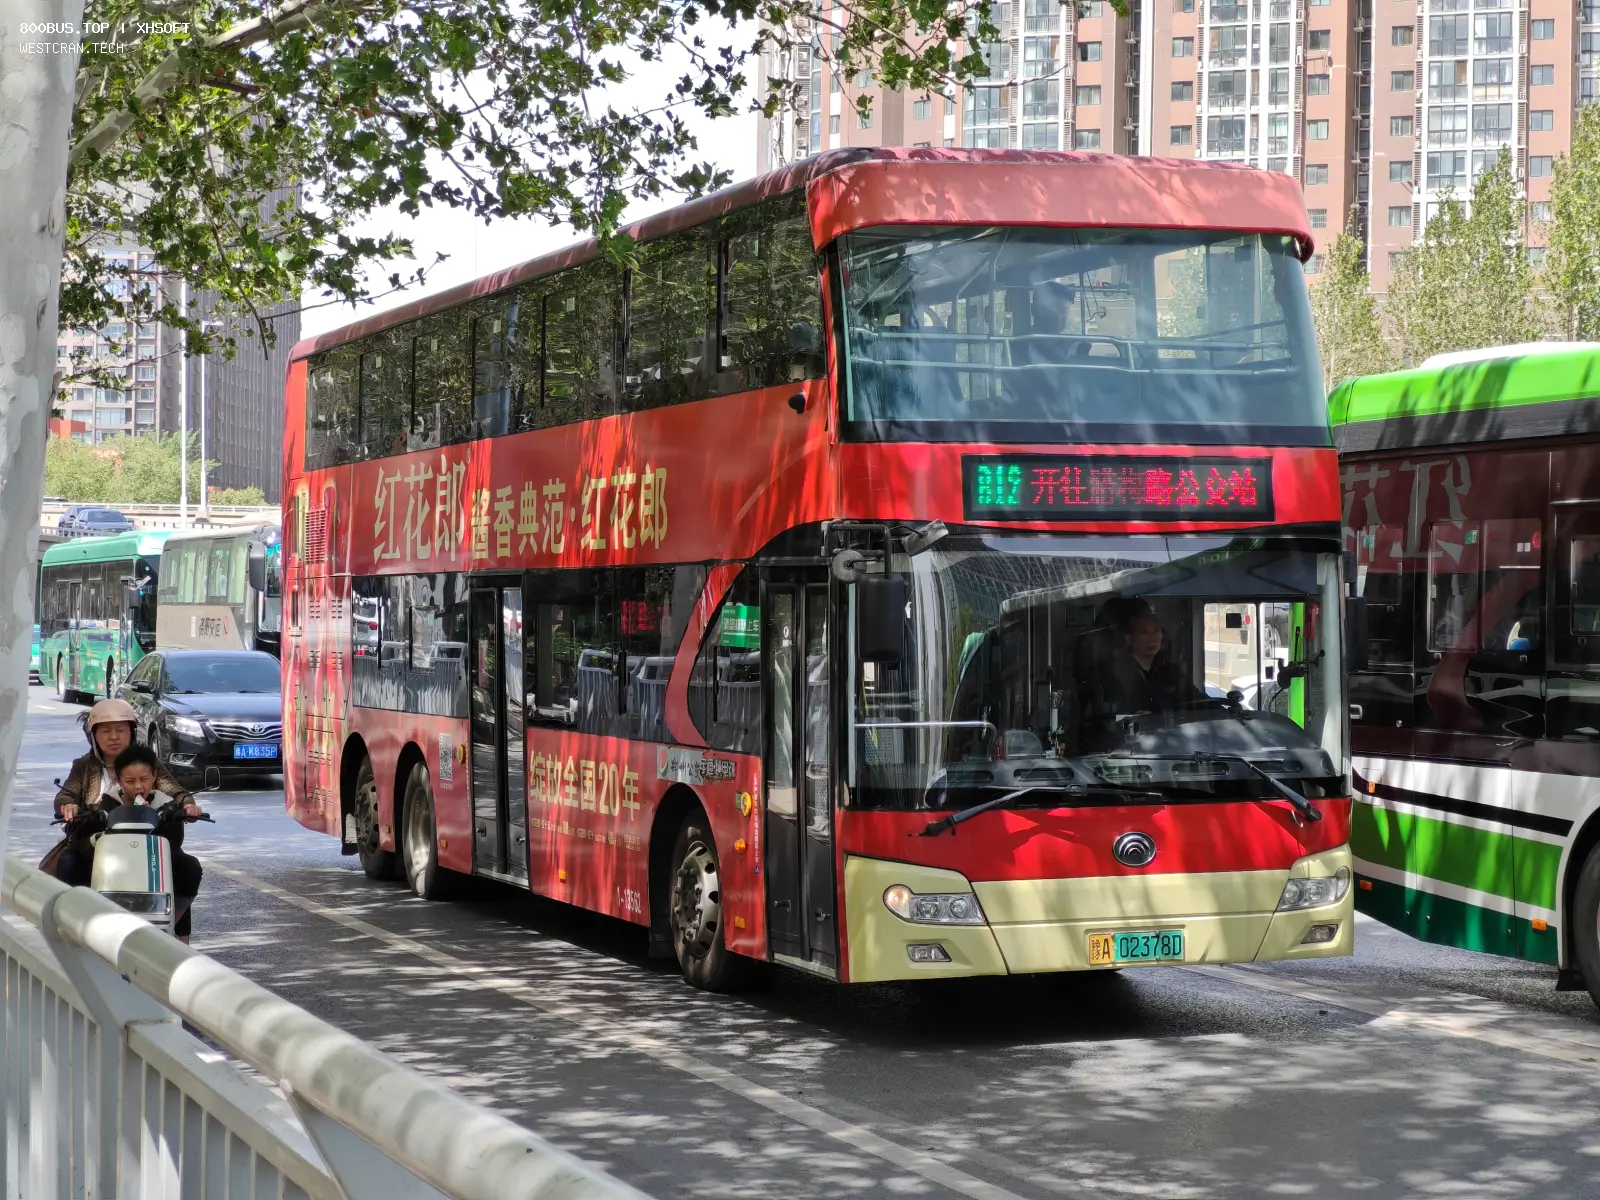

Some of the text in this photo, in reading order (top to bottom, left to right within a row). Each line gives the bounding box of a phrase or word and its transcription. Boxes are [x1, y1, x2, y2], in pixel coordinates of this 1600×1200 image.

[373, 454, 466, 565] 红花郎
[530, 749, 641, 822] 绽放全国20年
[1091, 934, 1182, 960] 豫A 02378D
